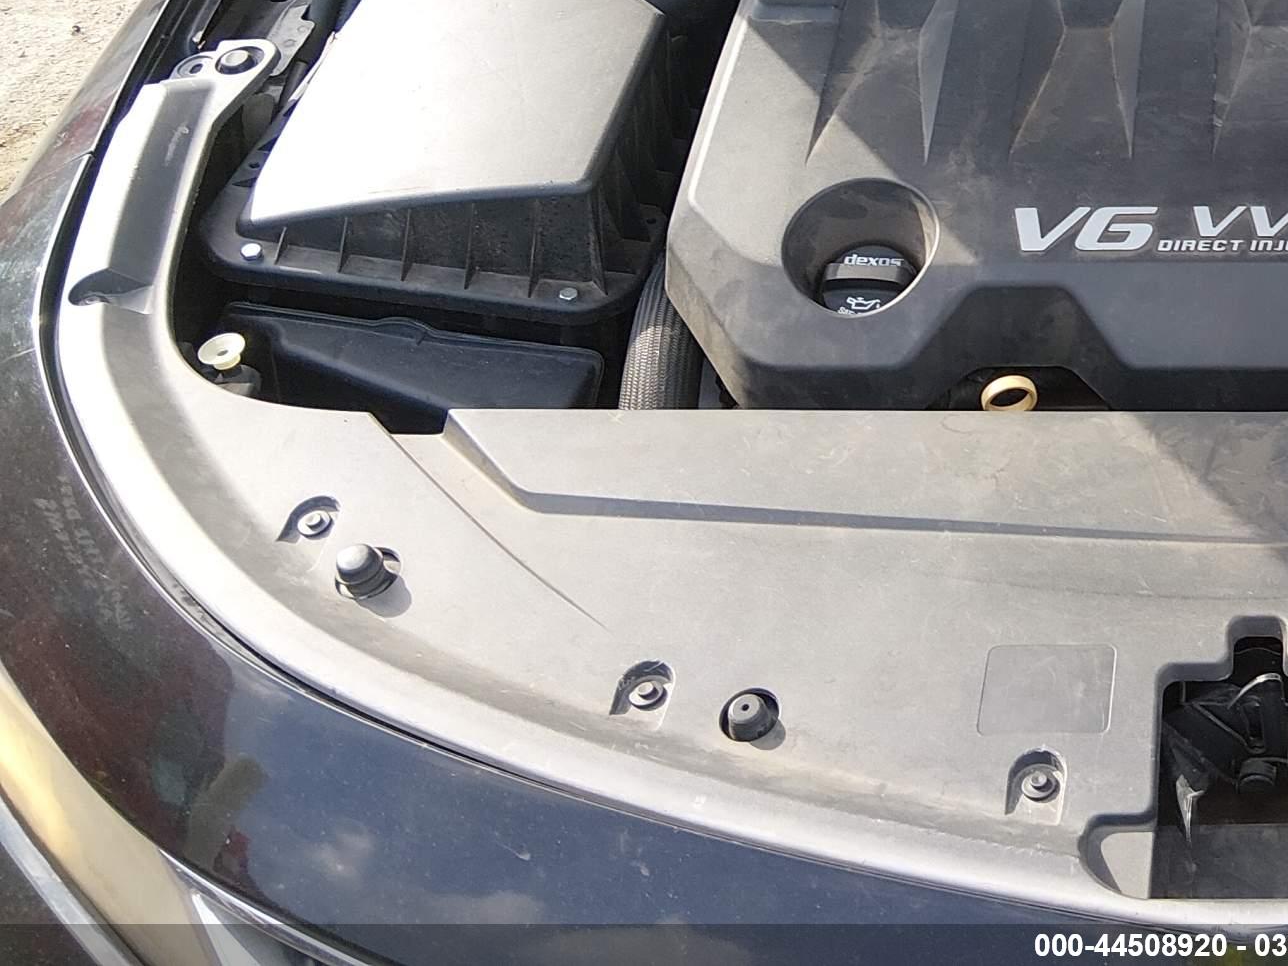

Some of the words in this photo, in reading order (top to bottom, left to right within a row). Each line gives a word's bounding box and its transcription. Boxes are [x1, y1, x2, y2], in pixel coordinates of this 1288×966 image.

[1014, 206, 1159, 252] V6
[1157, 239, 1240, 252] DIRECT
[843, 253, 904, 267] dexos
